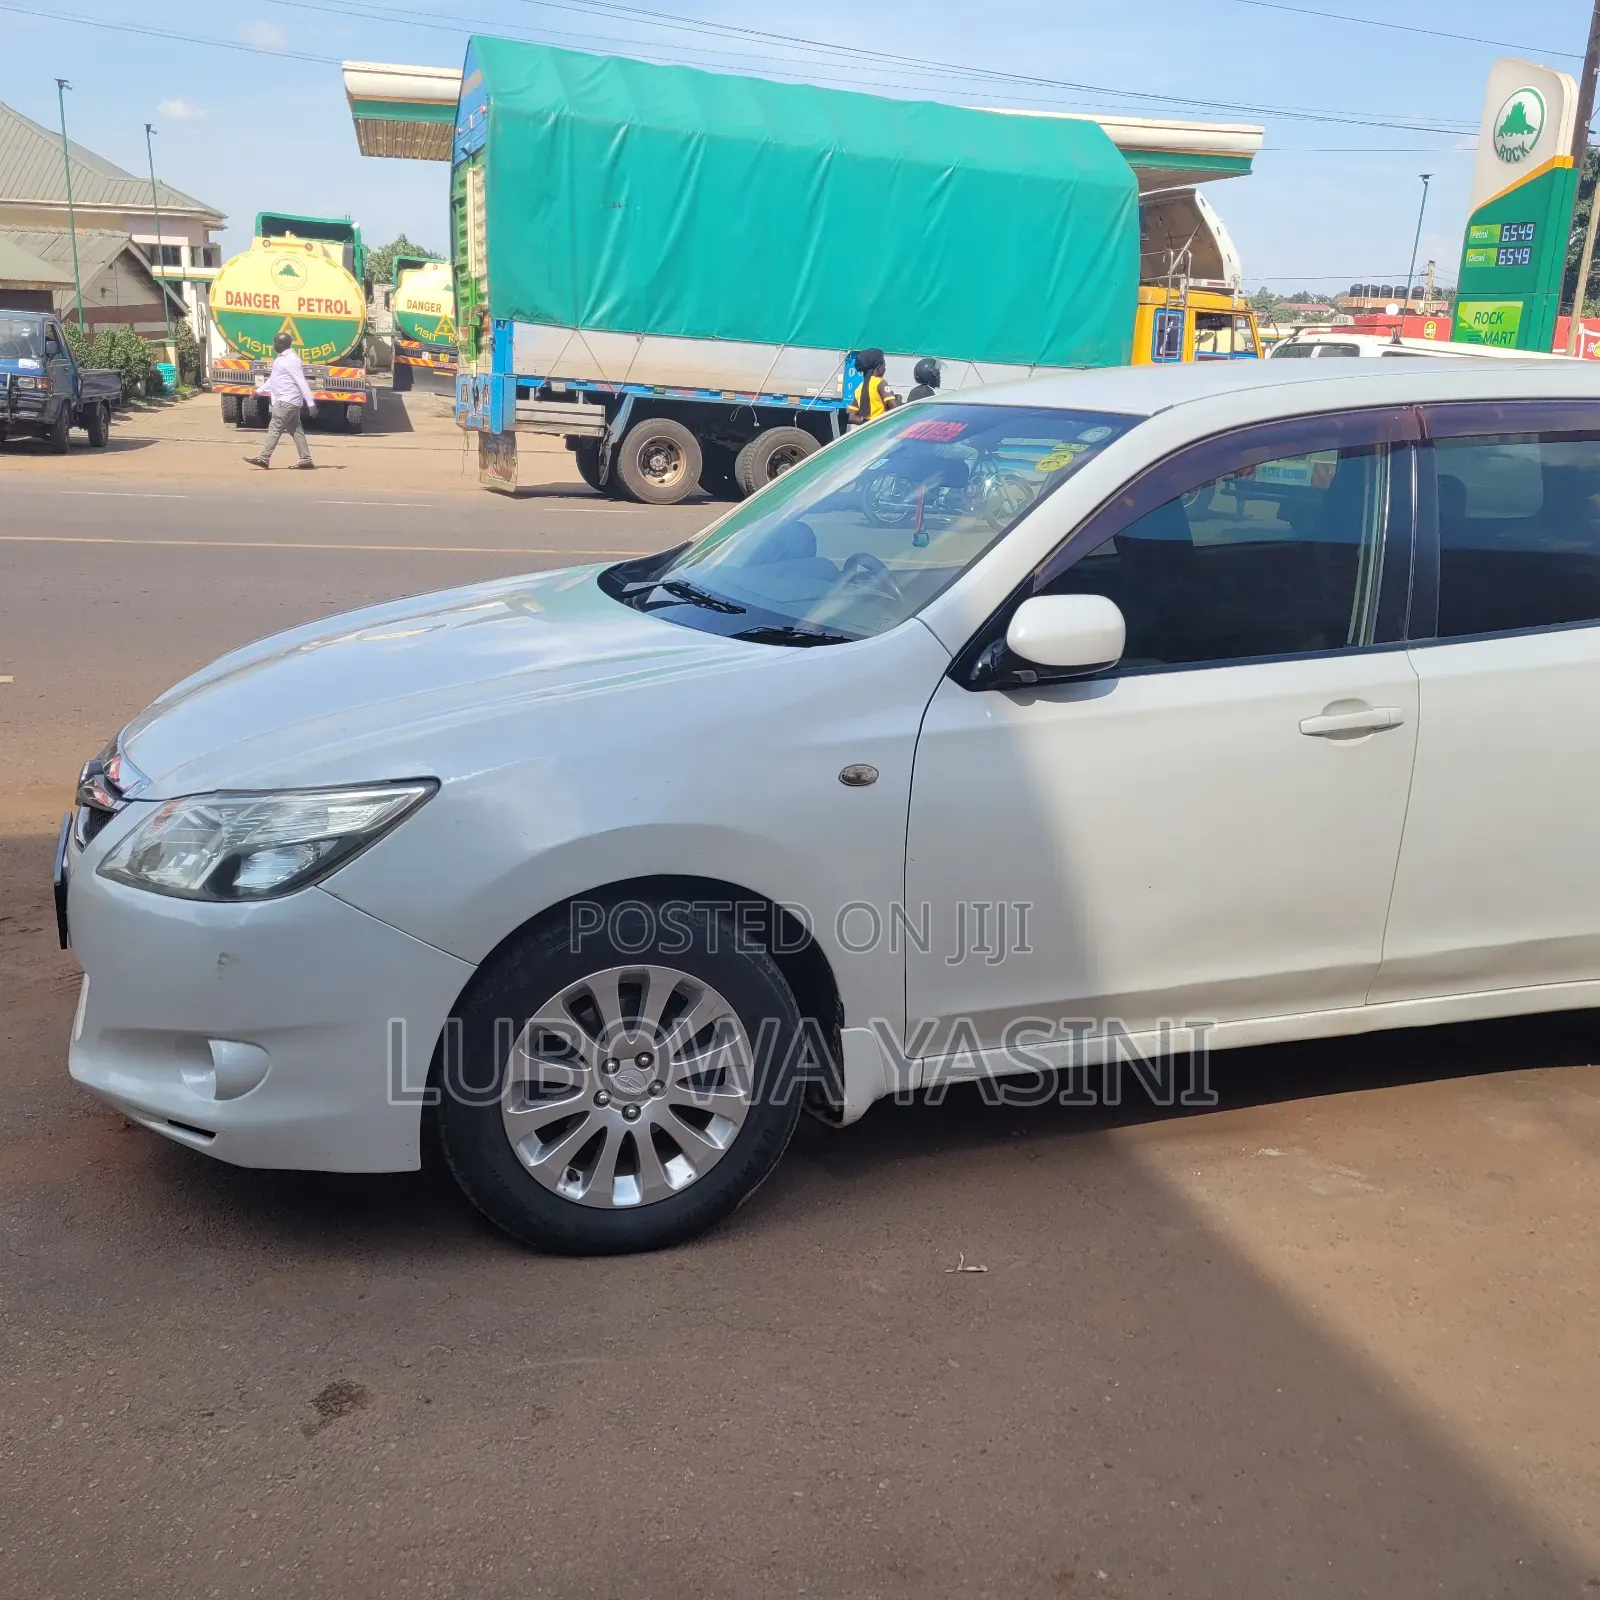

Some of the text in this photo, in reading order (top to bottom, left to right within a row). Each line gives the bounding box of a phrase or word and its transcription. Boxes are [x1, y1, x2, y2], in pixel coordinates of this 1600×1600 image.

[1498, 140, 1530, 163] ROCK
[1472, 224, 1535, 242] Petrol 6549
[1468, 248, 1531, 265] Diesel 6549
[225, 290, 352, 315] DANGER PETROL
[406, 299, 442, 313] DANGER
[1473, 311, 1505, 325] ROCK
[414, 323, 438, 342] VISIT
[1482, 331, 1516, 345] MART
[238, 331, 274, 357] VISIT
